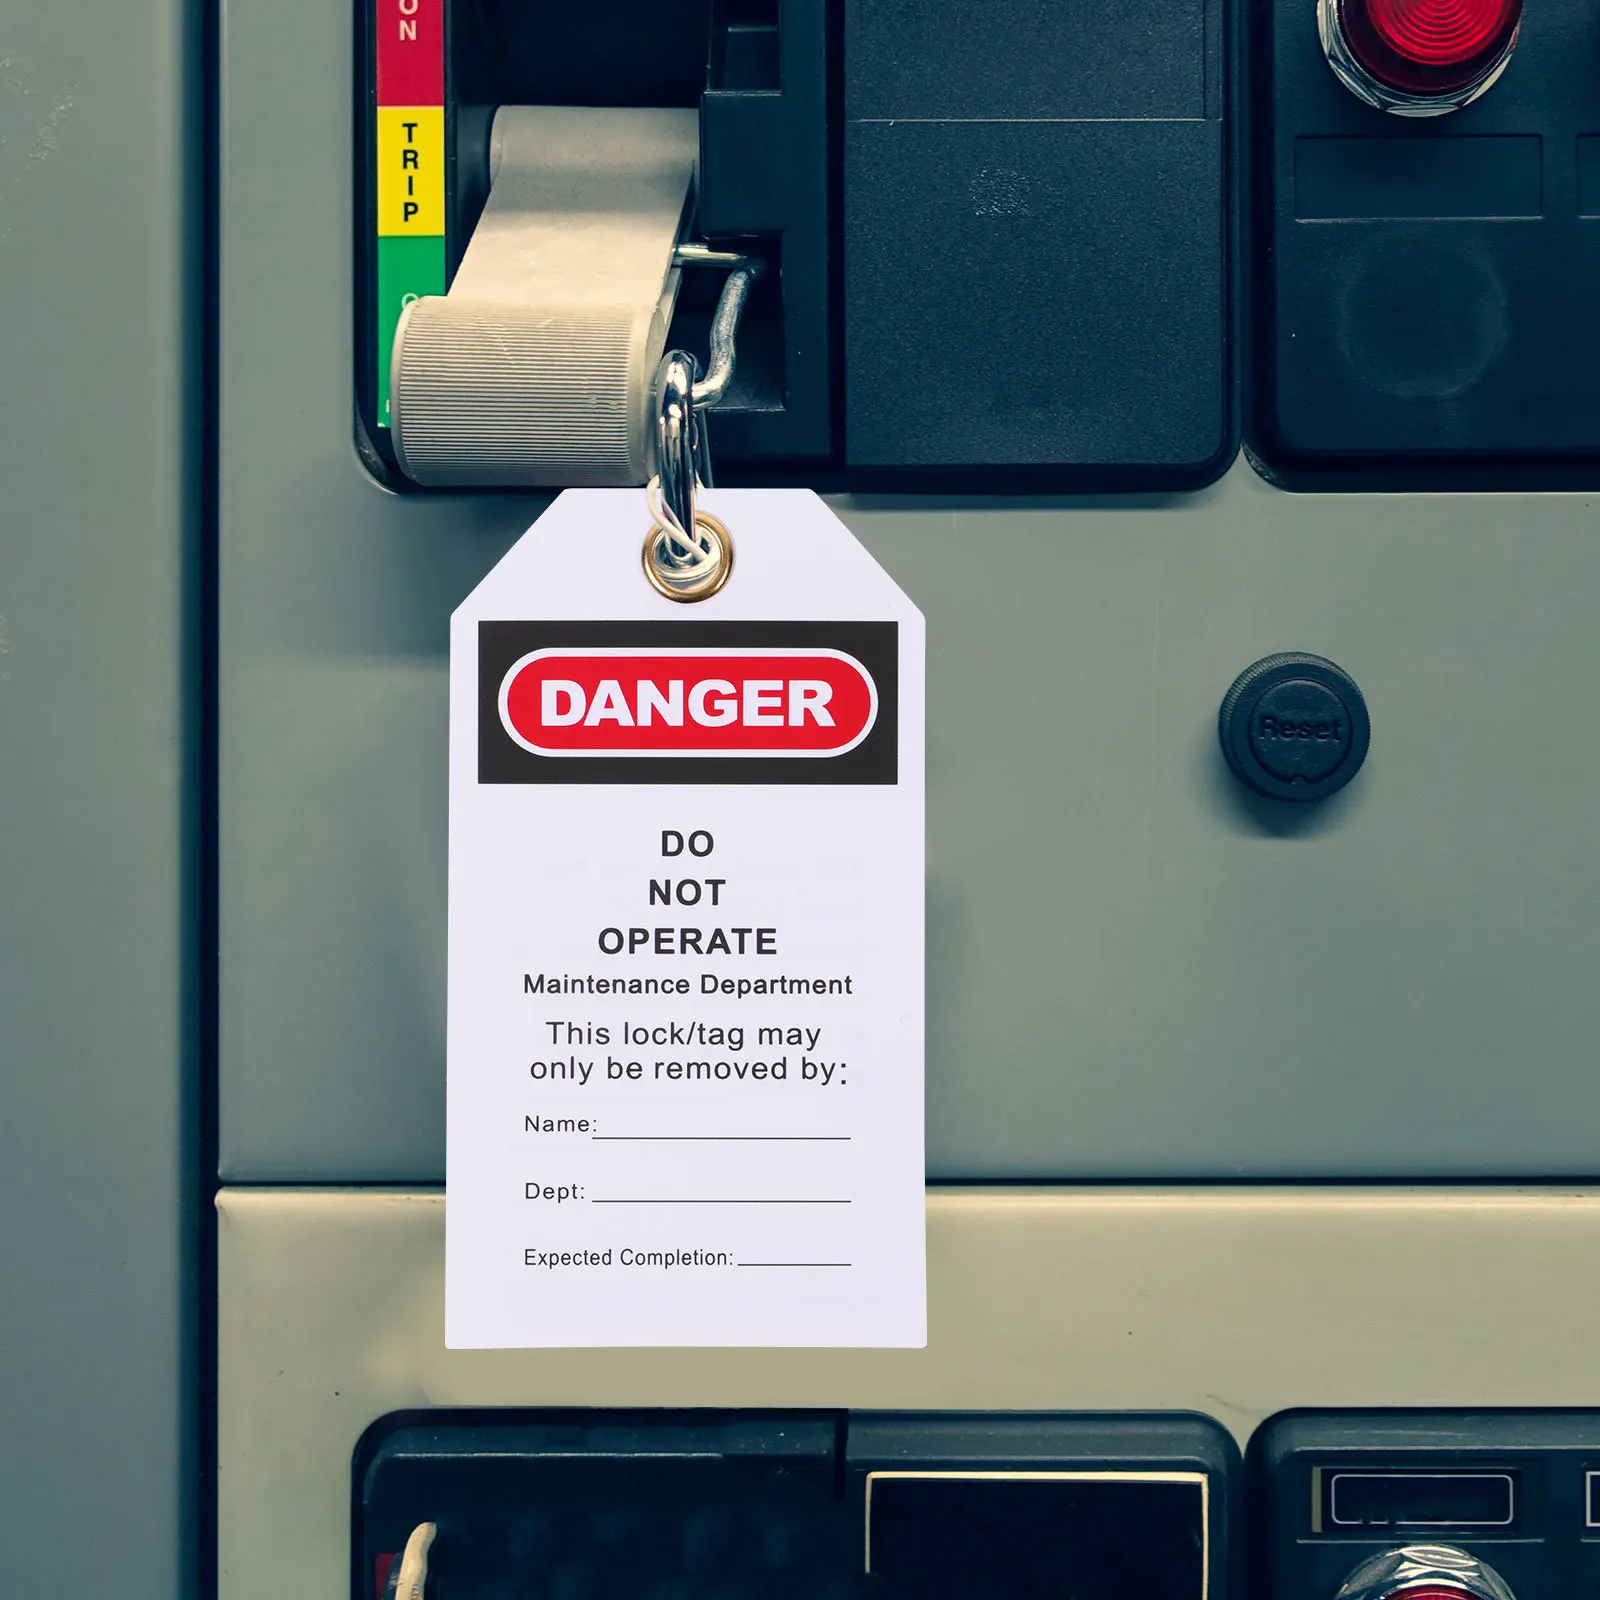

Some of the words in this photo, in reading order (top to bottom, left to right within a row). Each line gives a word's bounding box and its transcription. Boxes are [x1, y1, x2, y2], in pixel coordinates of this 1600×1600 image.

[399, 0, 419, 41] ON
[402, 123, 419, 222] TRIP
[541, 679, 836, 727] DANGER
[1258, 715, 1343, 743] Reset
[661, 830, 715, 857] DO
[649, 879, 726, 906] NOT
[598, 928, 777, 954] OPERATE
[524, 973, 690, 995] Maintenance
[700, 974, 853, 999] Department
[545, 1022, 611, 1046] This
[624, 1021, 744, 1051] lock/tag
[758, 1028, 821, 1051] may
[530, 1056, 594, 1086] only
[607, 1056, 643, 1080] be
[654, 1056, 787, 1080] removed
[801, 1056, 847, 1086] by:
[525, 1115, 597, 1132] Name:
[525, 1182, 585, 1204] Dept:
[524, 1248, 612, 1270] Expected
[620, 1248, 733, 1270] Completion:
